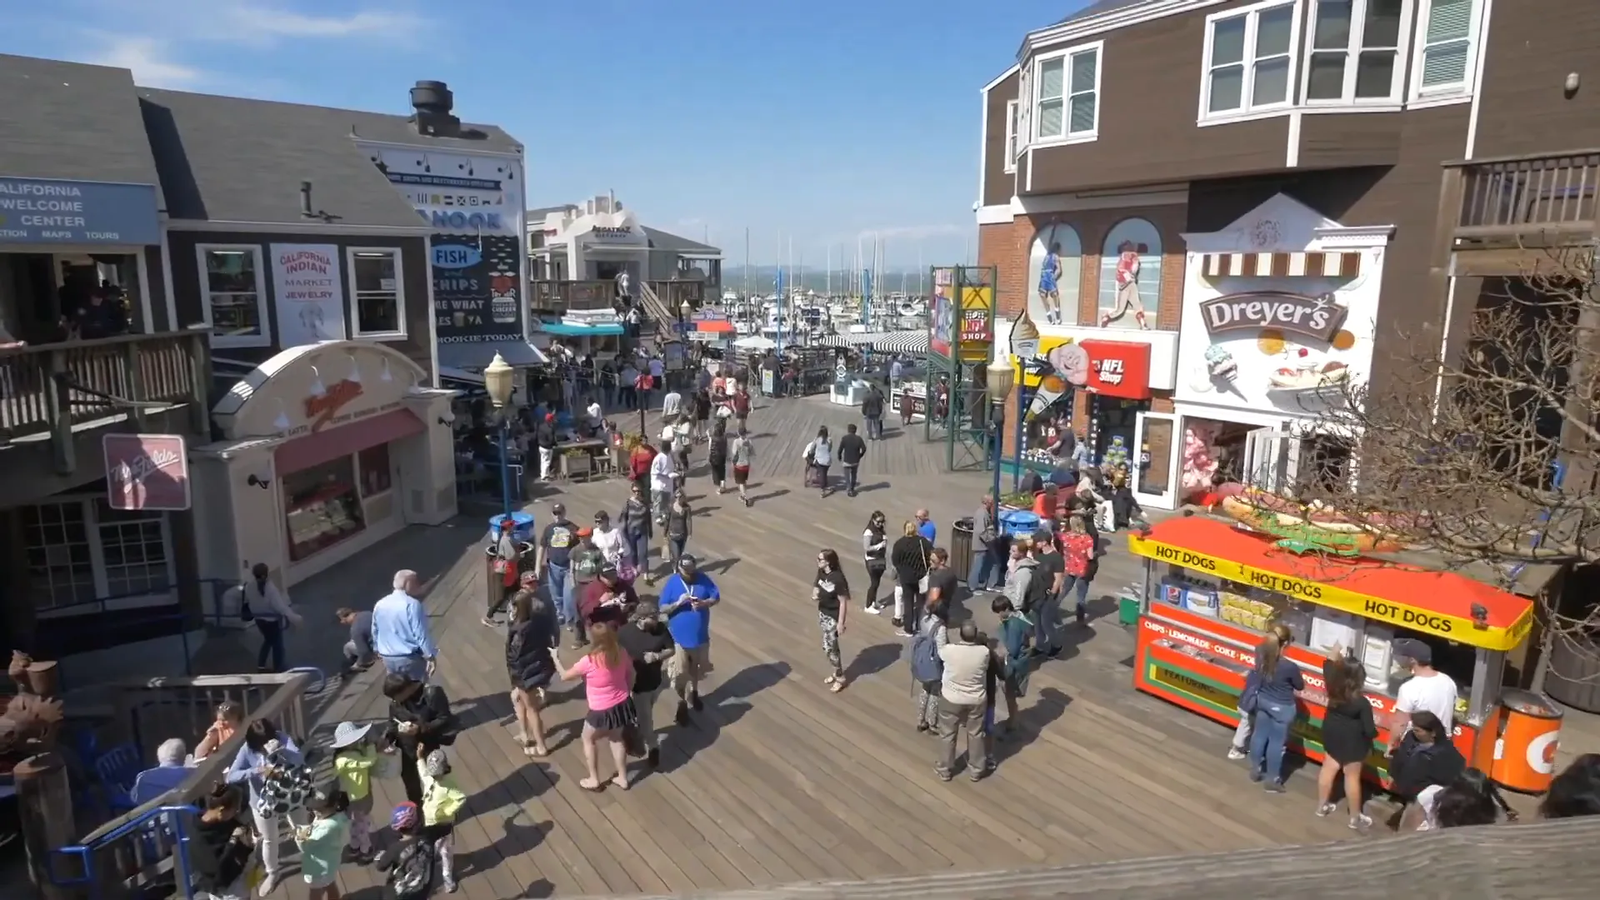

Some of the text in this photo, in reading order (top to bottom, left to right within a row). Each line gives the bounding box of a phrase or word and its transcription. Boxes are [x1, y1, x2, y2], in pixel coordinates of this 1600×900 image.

[3, 199, 83, 212] WELCOME
[21, 215, 85, 227] CENTER
[42, 230, 72, 238] MAPS
[85, 231, 119, 240] TOURS
[591, 224, 631, 234] ALCATRAZ
[280, 251, 331, 266] CALIFORNIA
[436, 250, 467, 264] FISH
[286, 261, 327, 275] INDIAN
[285, 279, 333, 287] MARKET
[285, 291, 333, 299] JEWELRY
[450, 300, 484, 310] WHAT
[467, 315, 483, 325] YA
[1207, 300, 1330, 330] Dreyer's
[482, 332, 521, 342] TODAY
[1101, 359, 1125, 373] NFL
[1099, 371, 1122, 385] Shop
[1155, 545, 1217, 571] HOT DOGS
[1250, 571, 1322, 600] HOT DOGS
[1364, 599, 1453, 634] HOT DOGS
[1144, 620, 1166, 634] CHIPS
[1168, 629, 1210, 650] LEMONADE
[1213, 644, 1236, 659] COKE
